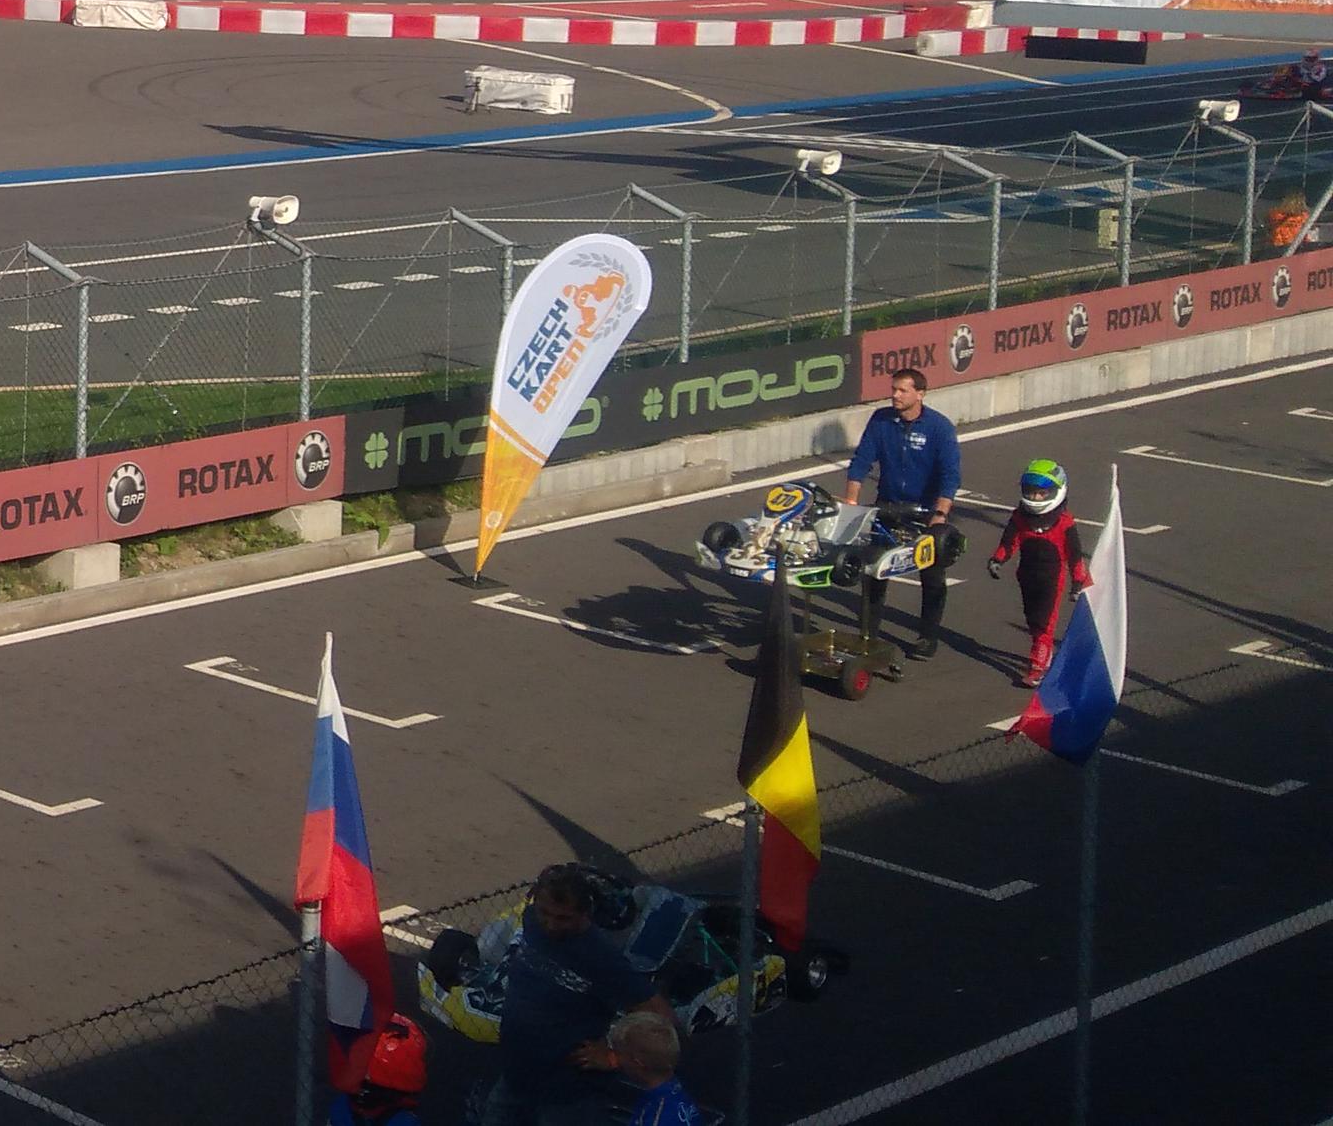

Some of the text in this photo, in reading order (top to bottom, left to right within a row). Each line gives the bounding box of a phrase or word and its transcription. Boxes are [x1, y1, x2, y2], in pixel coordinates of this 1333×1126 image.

[1210, 282, 1261, 311] ROTAX
[1106, 300, 1162, 332] ROTAX
[507, 298, 569, 390] CZECH
[994, 321, 1054, 353] ROTAX
[519, 321, 574, 402] KART
[533, 339, 586, 414] OPEN
[871, 343, 936, 377] ROTAX
[670, 354, 846, 419] MOJO
[178, 455, 275, 499] ROTAX
[308, 459, 331, 473] BRP
[121, 492, 145, 507] BRP
